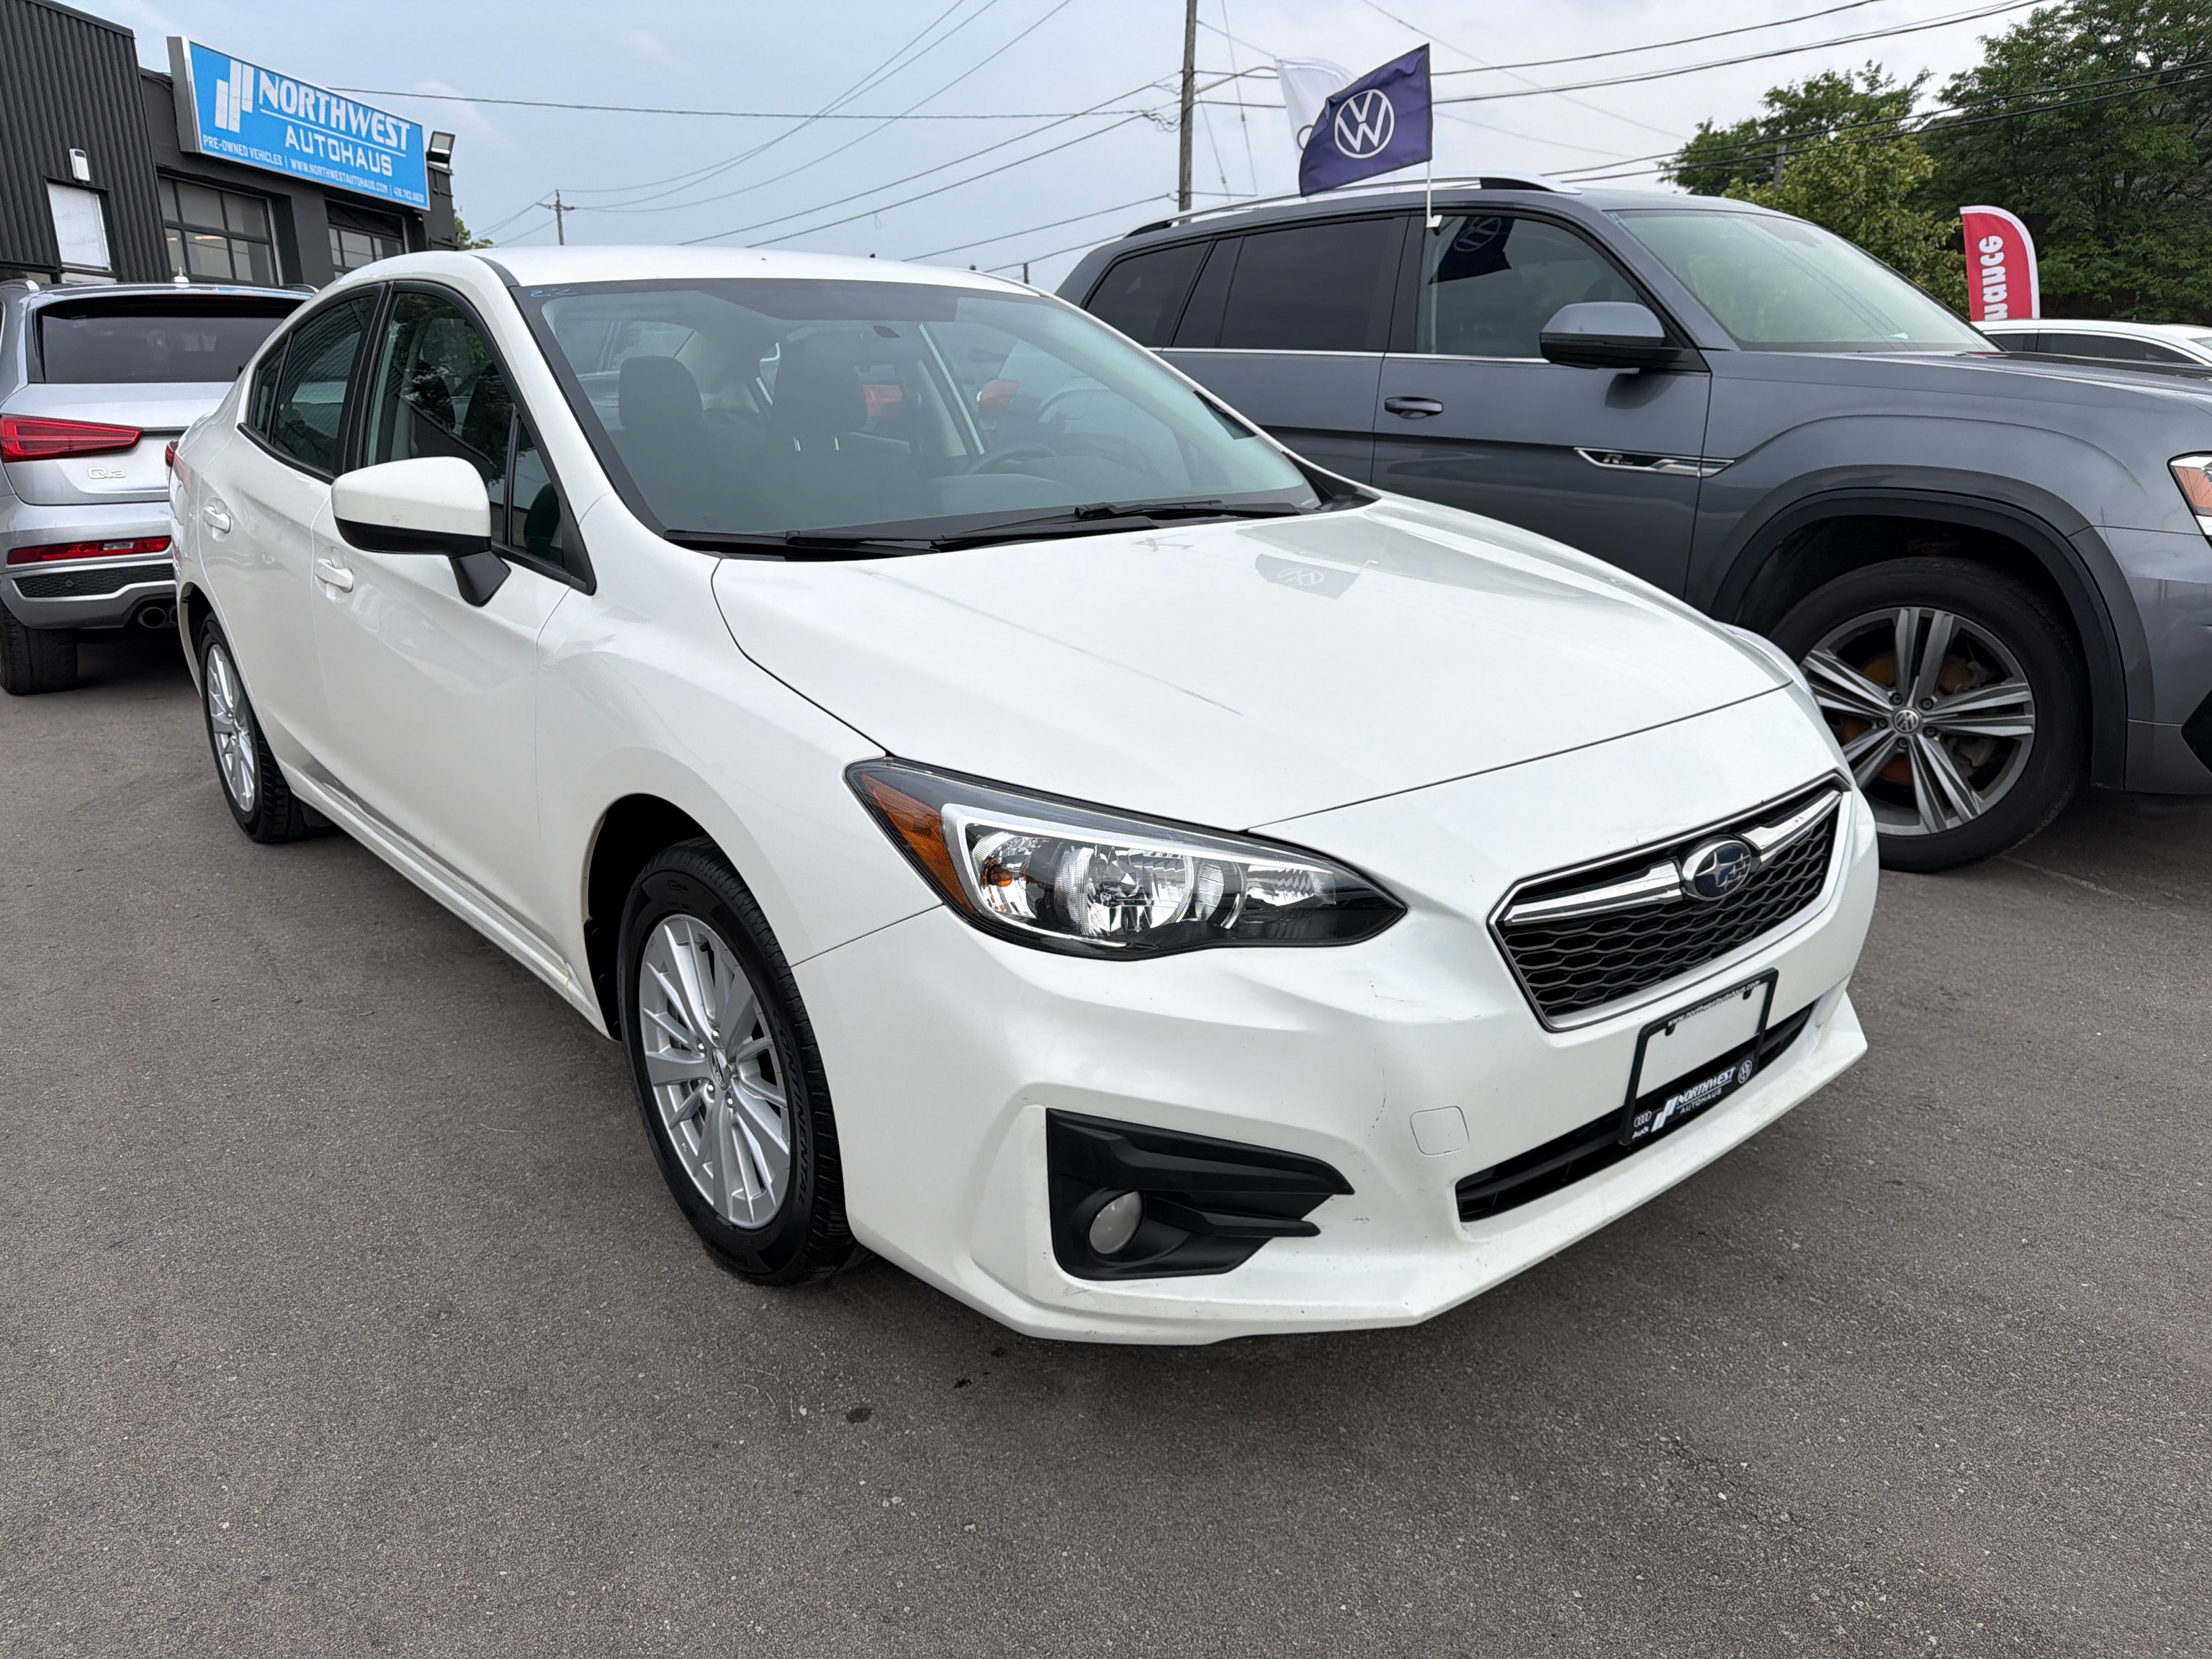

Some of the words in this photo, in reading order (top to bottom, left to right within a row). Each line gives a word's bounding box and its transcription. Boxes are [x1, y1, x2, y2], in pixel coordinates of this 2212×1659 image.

[259, 70, 410, 150] NORTHWEST
[1336, 91, 1388, 153] VW
[203, 135, 248, 157] PRE-OWNED
[249, 146, 283, 166] VEHICLES
[285, 125, 393, 176] AUTOHAUS
[88, 467, 125, 479] Q3
[1676, 1066, 1736, 1106] NORTHWEST
[1680, 1088, 1722, 1115] AUTOHAUS
